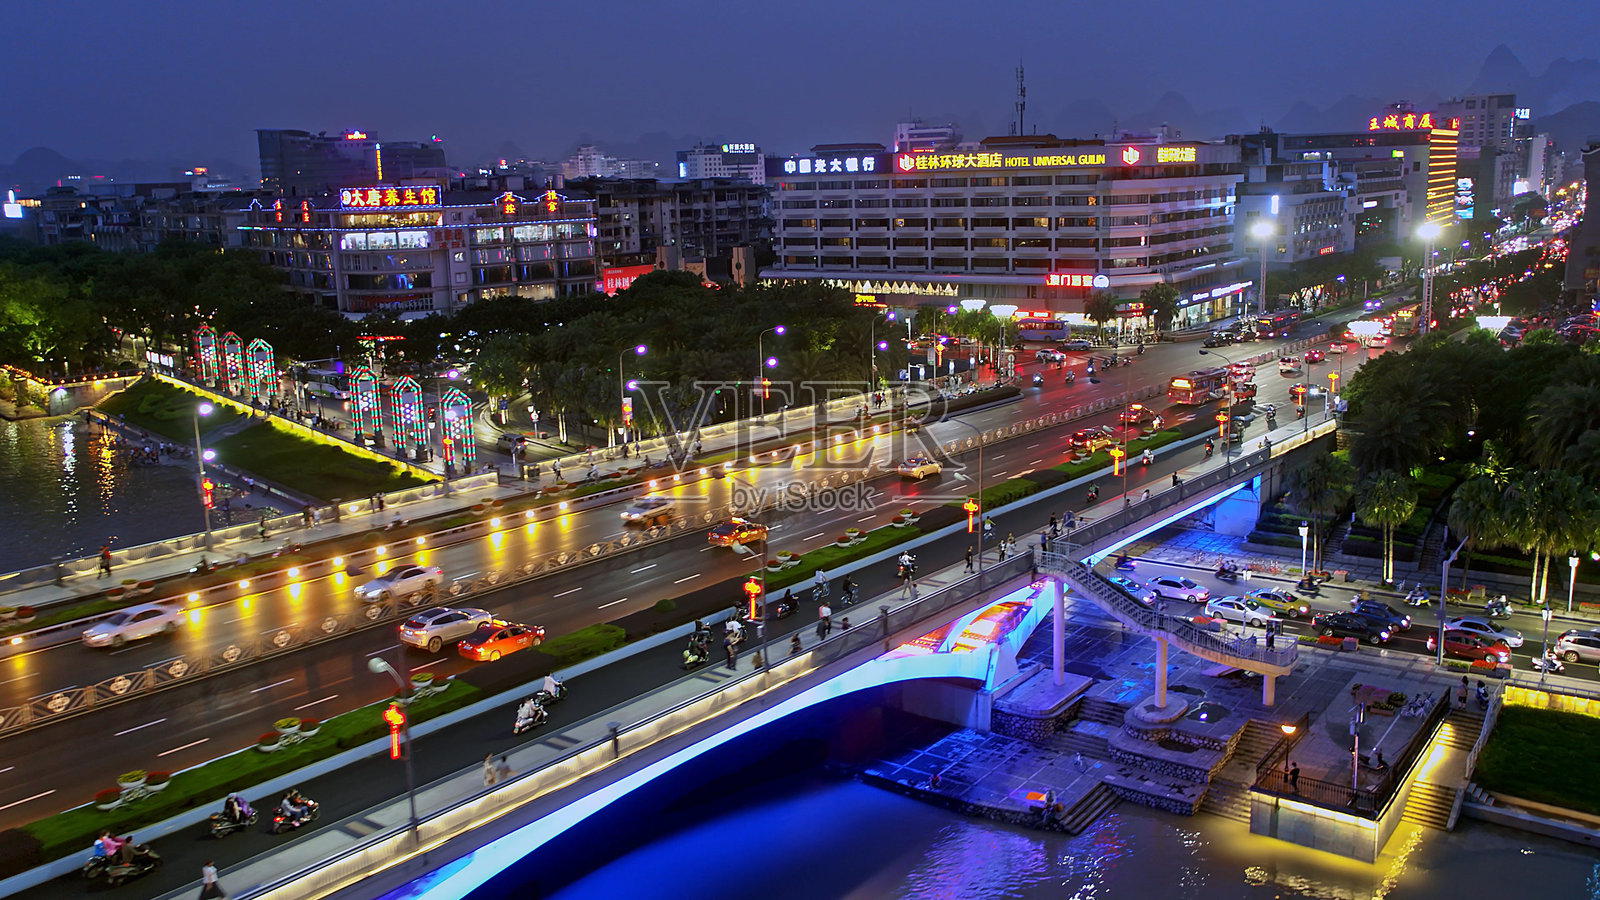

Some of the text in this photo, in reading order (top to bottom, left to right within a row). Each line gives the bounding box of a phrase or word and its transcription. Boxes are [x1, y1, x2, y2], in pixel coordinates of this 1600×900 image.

[1368, 113, 1433, 131] 王城商厦
[784, 156, 875, 174] 中国光大银行
[915, 152, 1002, 170] 桂林环球大酒店
[1004, 153, 1106, 167] HOTEL UNIVERSAL GUILIN
[350, 188, 436, 208] 大唐养生馆
